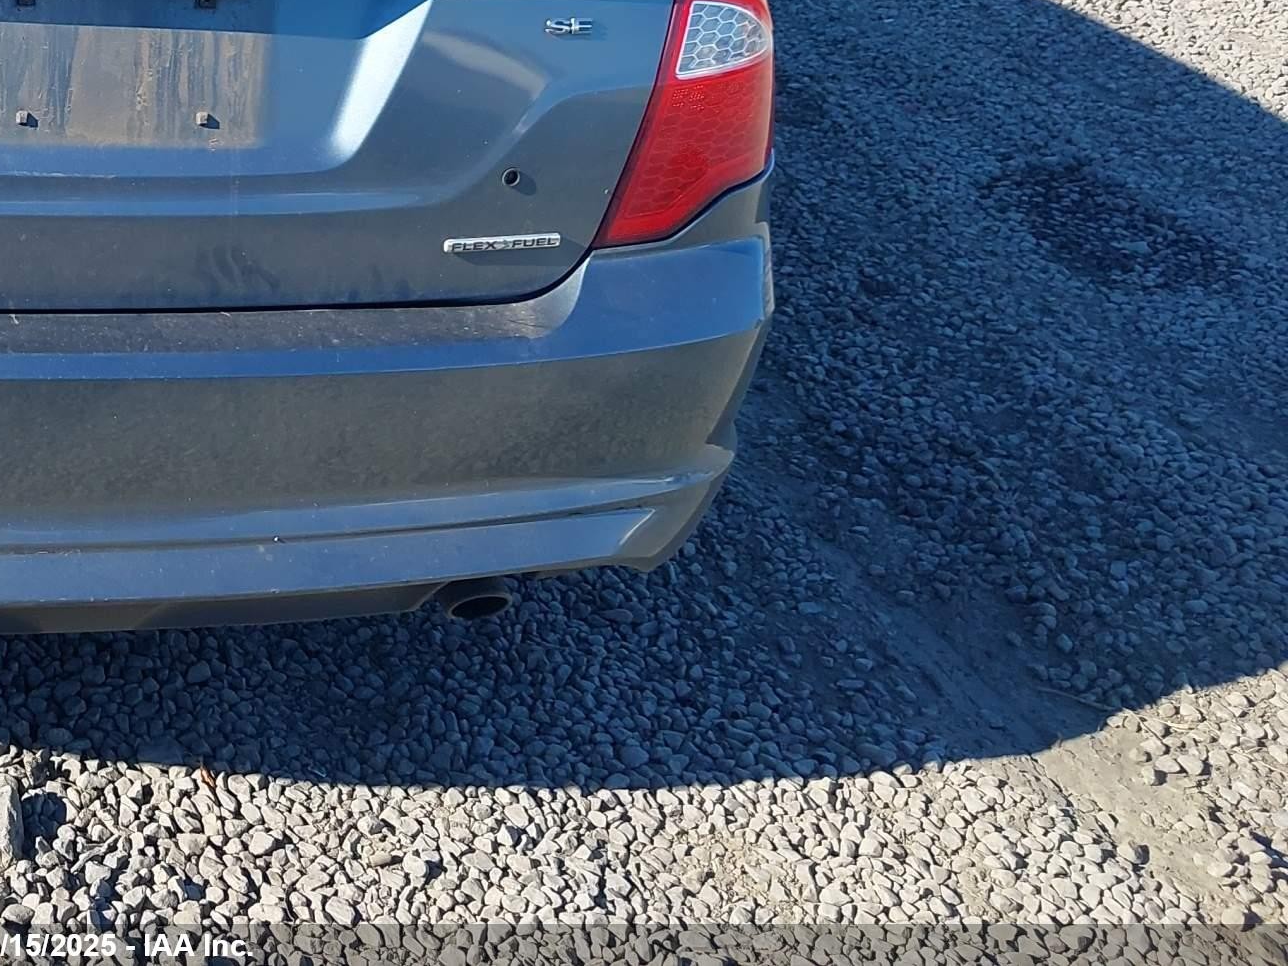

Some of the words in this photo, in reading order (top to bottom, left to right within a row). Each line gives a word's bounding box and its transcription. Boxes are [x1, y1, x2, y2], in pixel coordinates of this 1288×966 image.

[544, 17, 593, 35] SE
[451, 240, 498, 252] FLEX
[511, 237, 559, 248] FUEL
